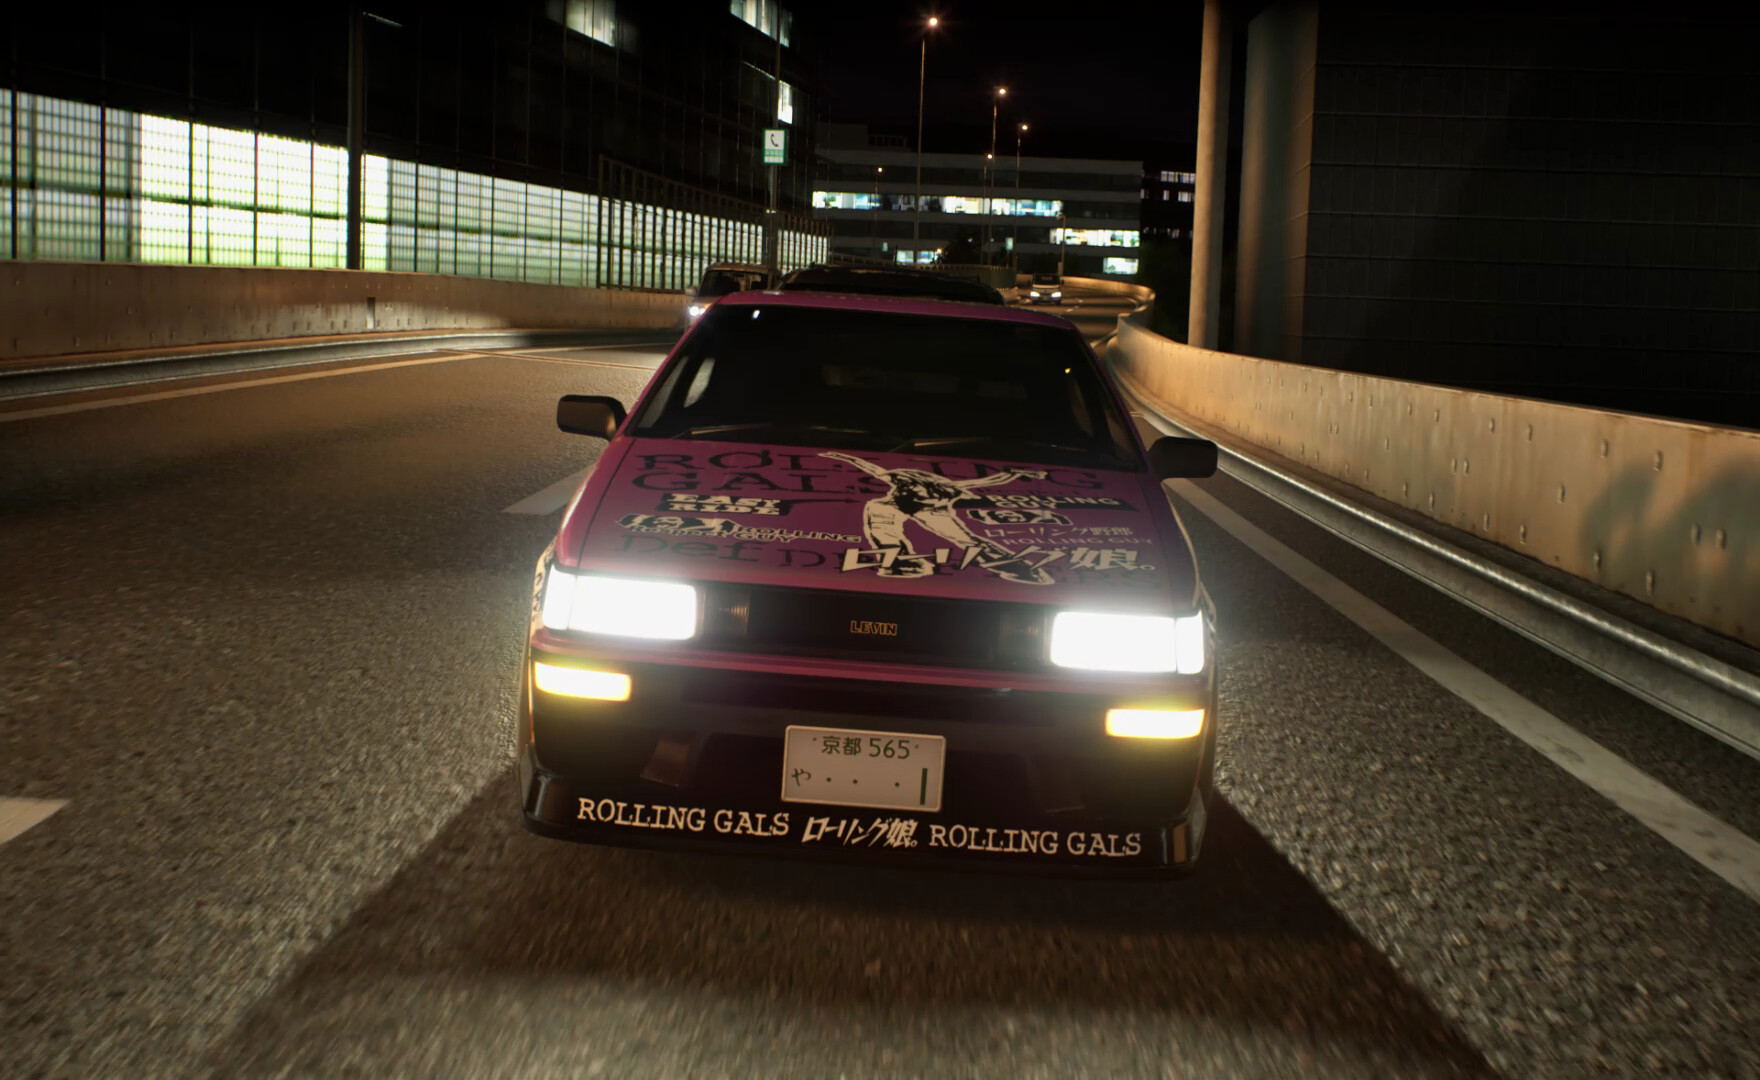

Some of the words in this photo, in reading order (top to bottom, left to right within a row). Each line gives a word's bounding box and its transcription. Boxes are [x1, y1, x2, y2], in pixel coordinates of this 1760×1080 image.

[667, 493, 781, 508] EASY
[986, 494, 1121, 505] ROLLING
[995, 500, 1057, 509] GUY
[668, 503, 780, 516] RIDE
[1003, 537, 1104, 545] ROLLING
[849, 620, 897, 636] LEVIN
[821, 735, 861, 756] 京都
[868, 738, 911, 759] 565
[791, 768, 811, 786] や
[577, 797, 706, 832] ROLLING
[713, 809, 790, 837] GALS
[929, 823, 1059, 856] ROLLING
[1066, 831, 1142, 857] GALS
